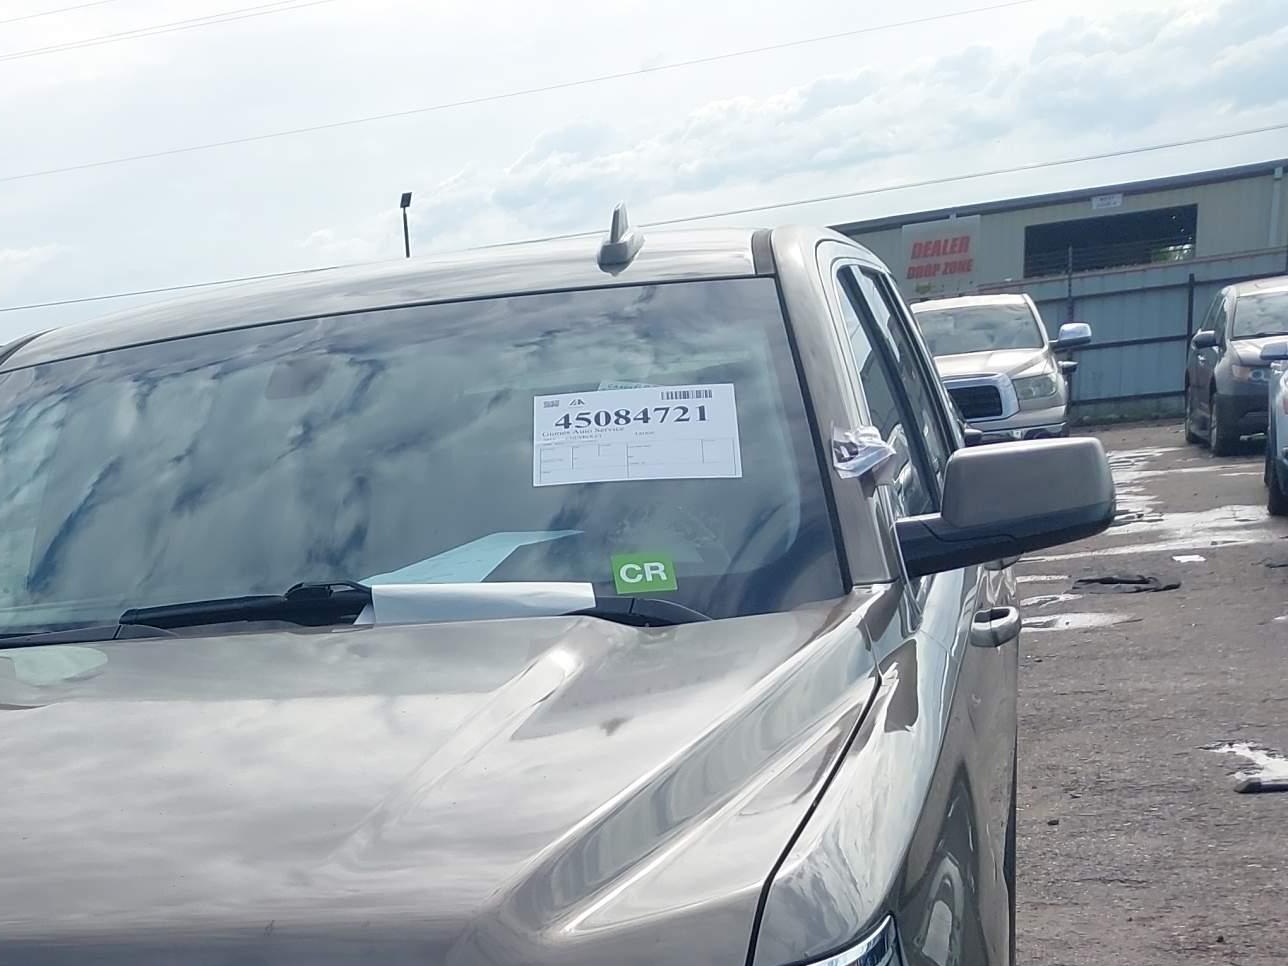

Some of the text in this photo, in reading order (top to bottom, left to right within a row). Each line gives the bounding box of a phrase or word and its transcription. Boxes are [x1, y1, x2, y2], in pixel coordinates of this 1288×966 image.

[910, 235, 970, 260] DEALER
[906, 258, 973, 280] DROP ZONE
[555, 405, 708, 430] 45084721
[619, 561, 668, 583] CR
